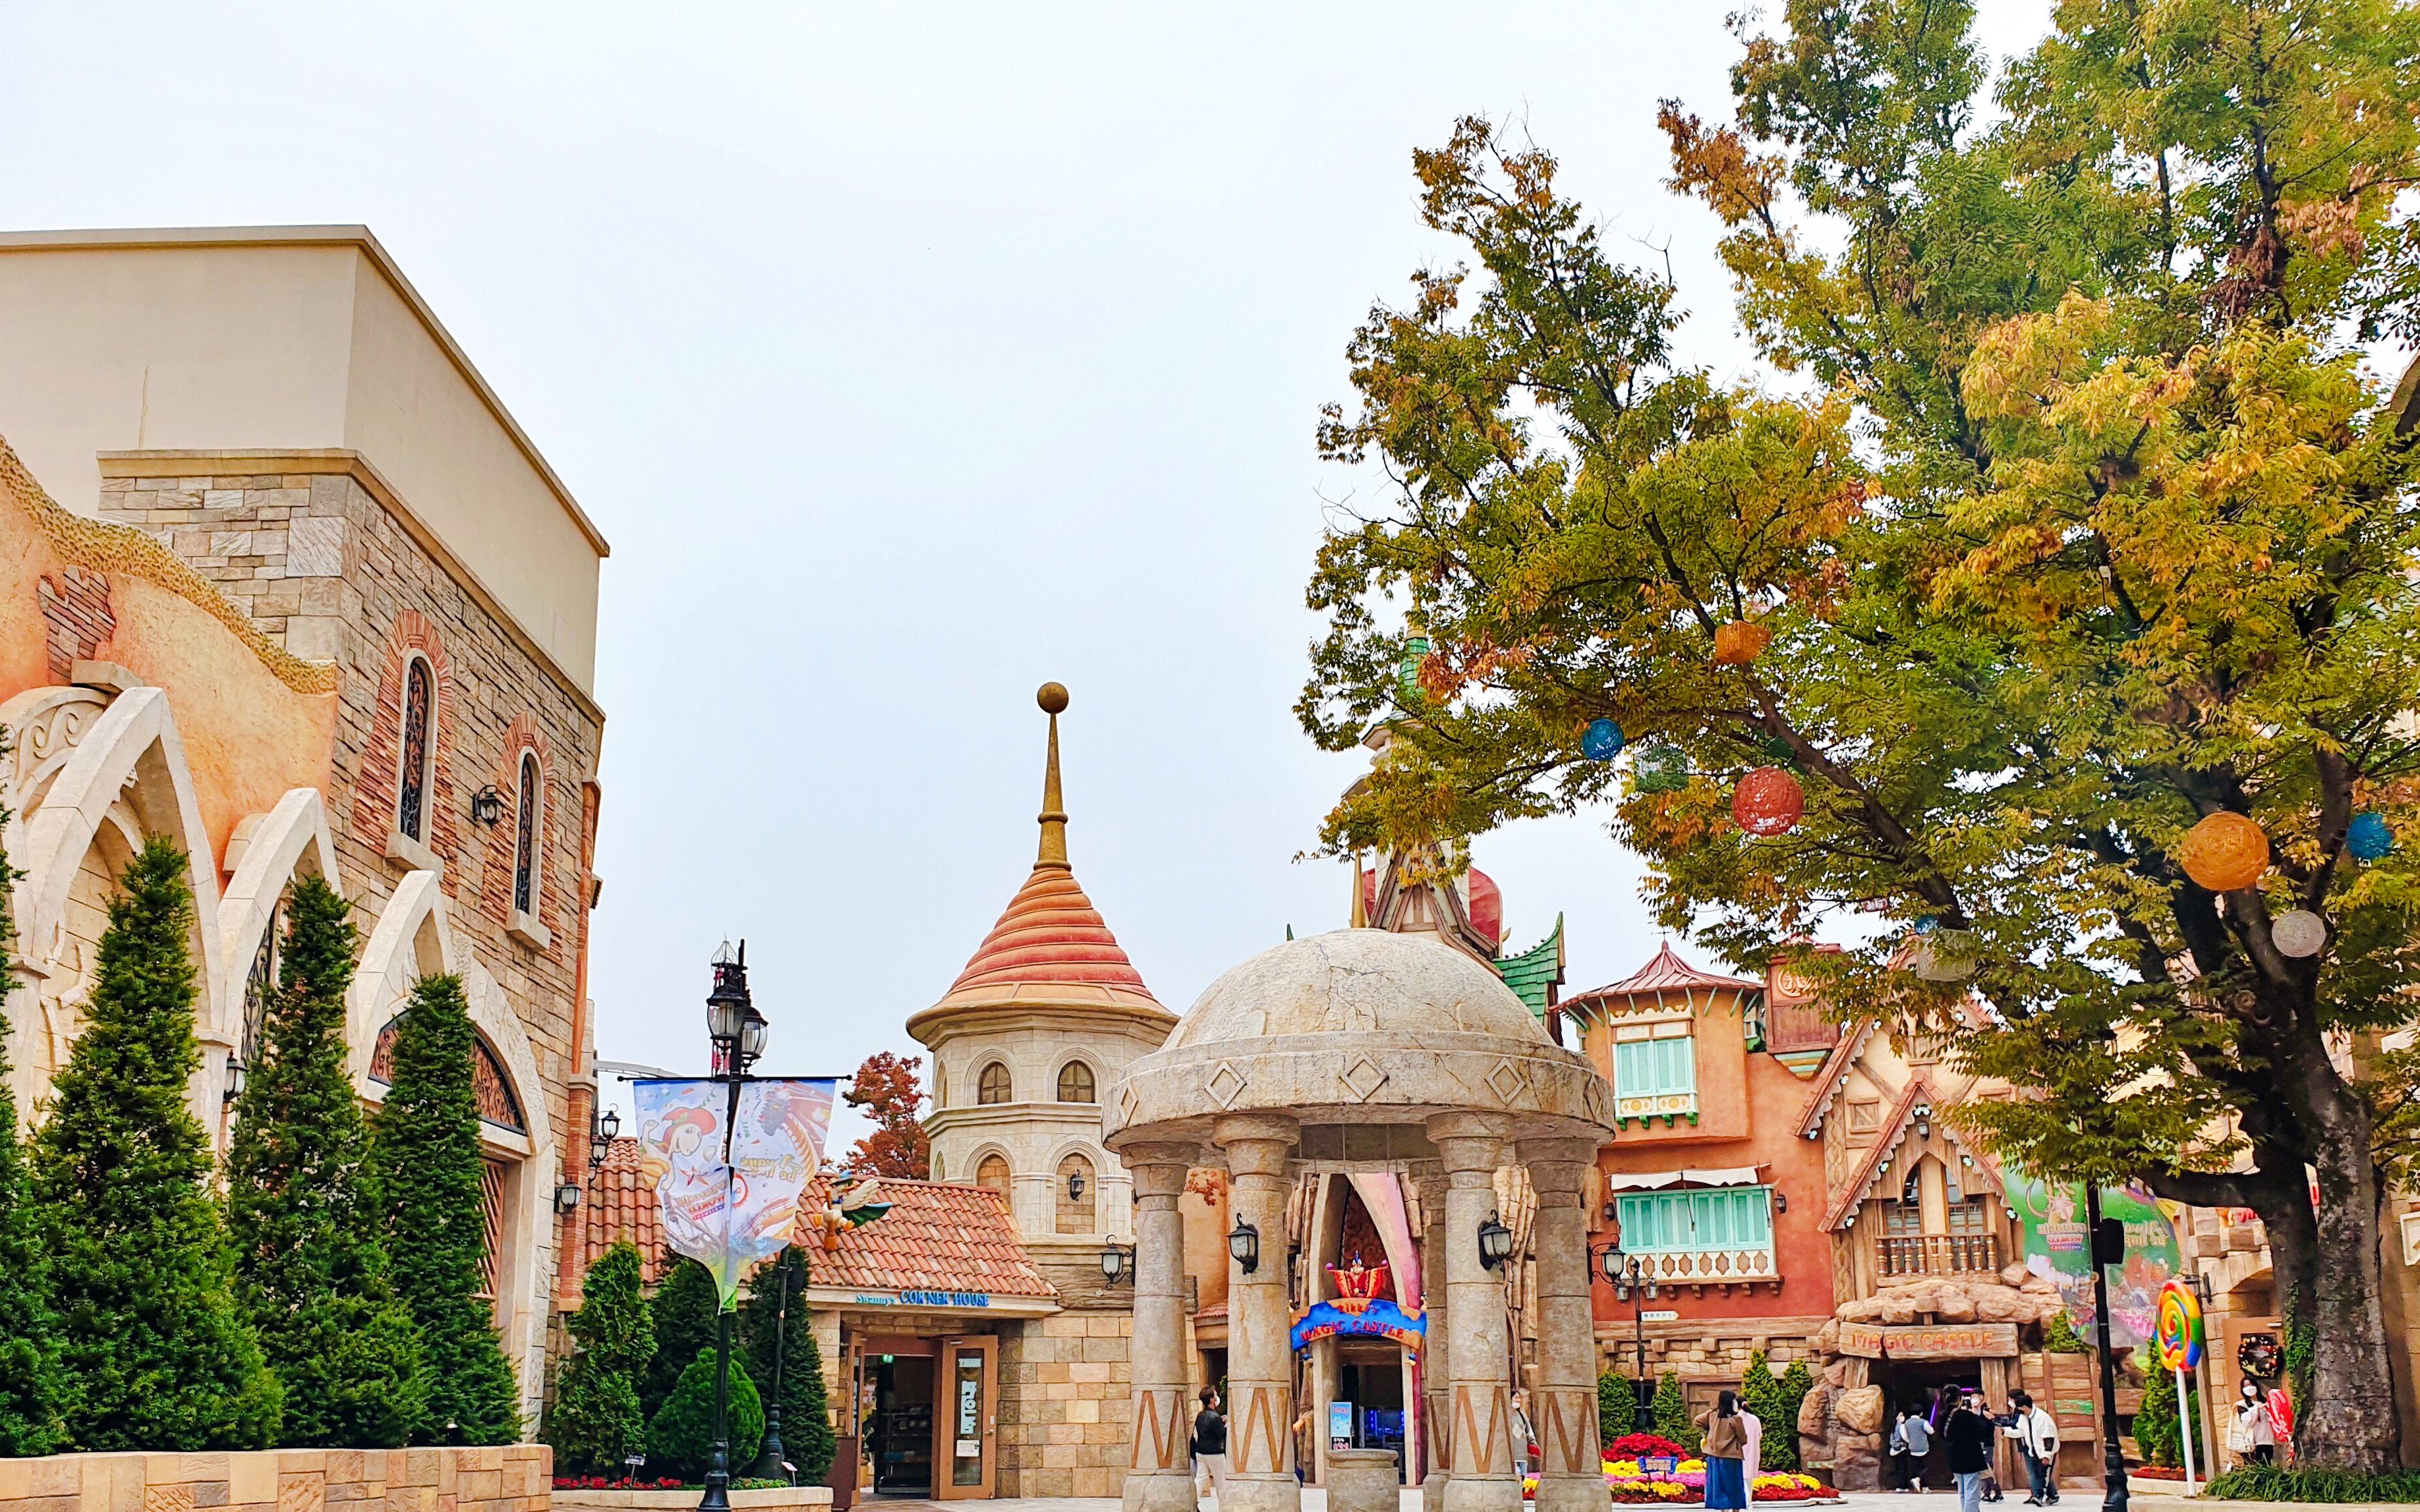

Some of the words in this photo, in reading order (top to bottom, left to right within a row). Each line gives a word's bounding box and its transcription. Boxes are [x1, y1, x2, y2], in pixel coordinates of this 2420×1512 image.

[900, 1290, 950, 1305] CORNER
[953, 1292, 989, 1306] HOUSE
[1300, 1320, 1345, 1342] MAGIC
[1352, 1320, 1405, 1339] CASTLE
[1851, 1331, 1914, 1350] MAGIC
[1920, 1331, 1994, 1350] CASTLE
